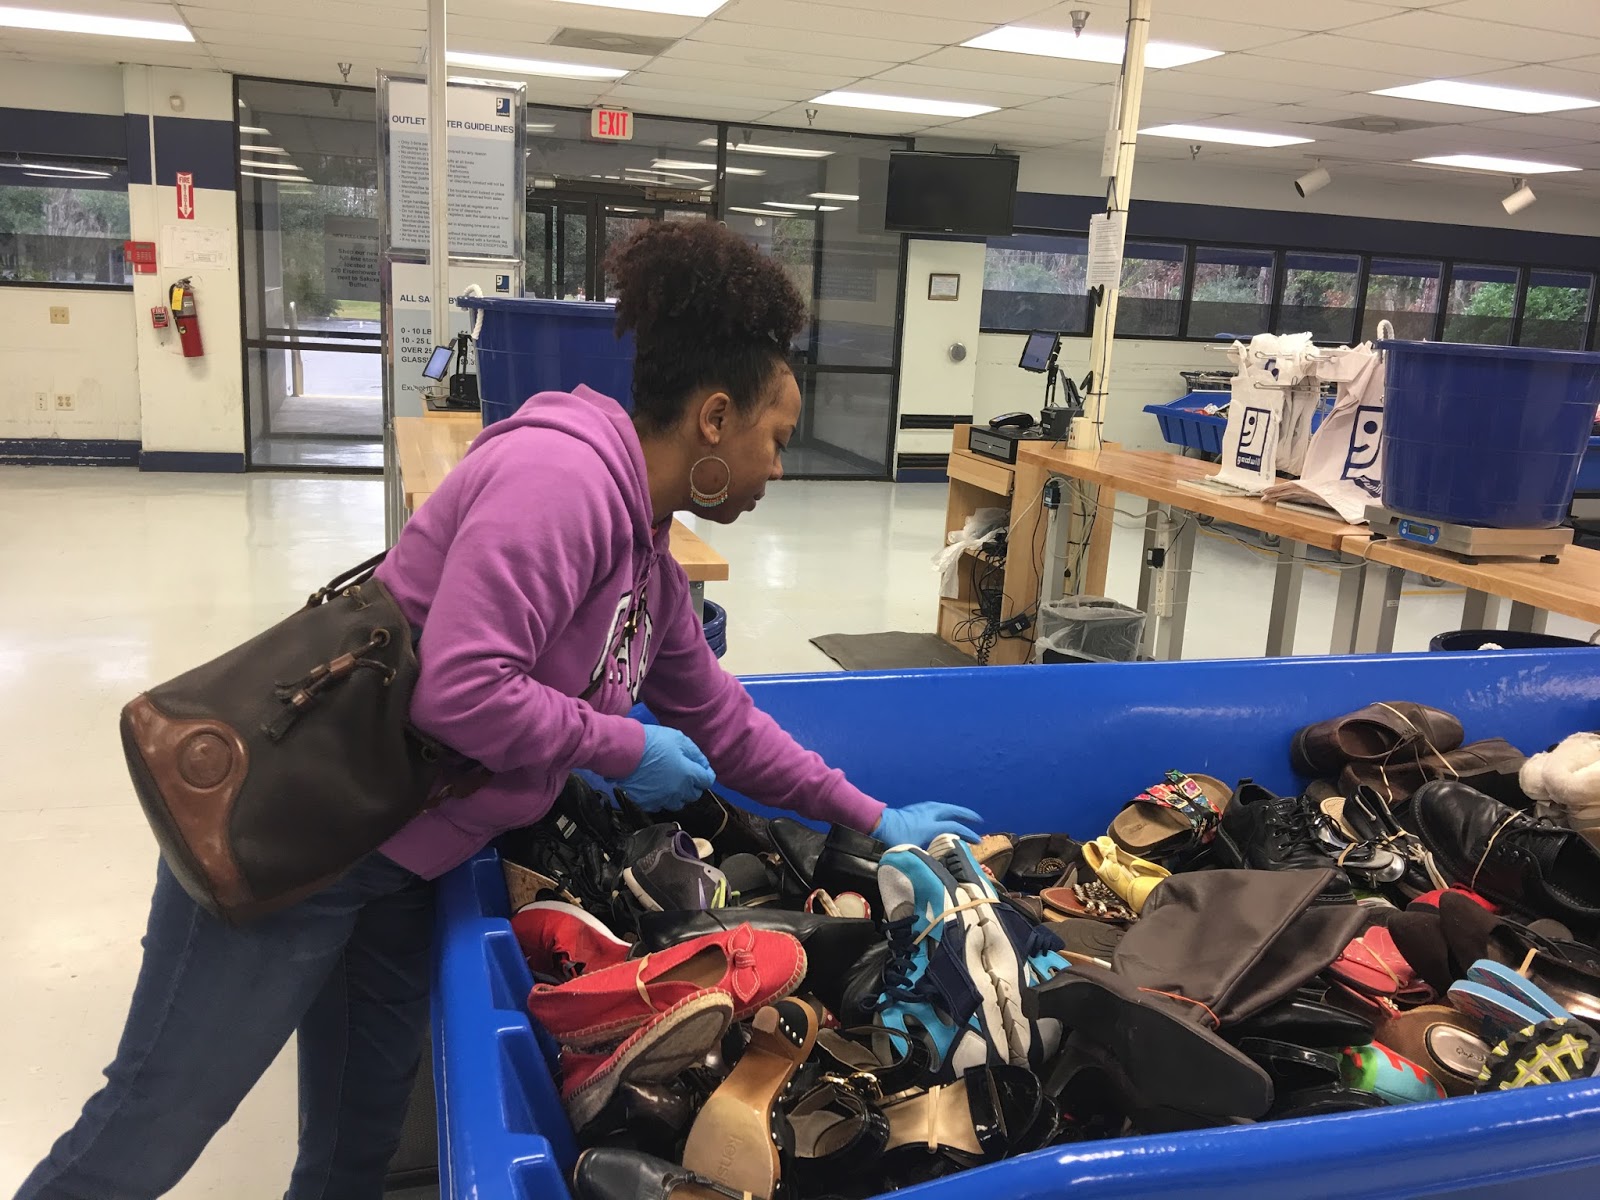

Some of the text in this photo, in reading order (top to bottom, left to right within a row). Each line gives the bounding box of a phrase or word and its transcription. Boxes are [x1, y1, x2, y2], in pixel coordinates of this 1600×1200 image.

[392, 115, 426, 125] OUTLET
[464, 122, 514, 133] GUIDELINES
[599, 111, 628, 136] EXIT
[400, 294, 416, 302] ALL
